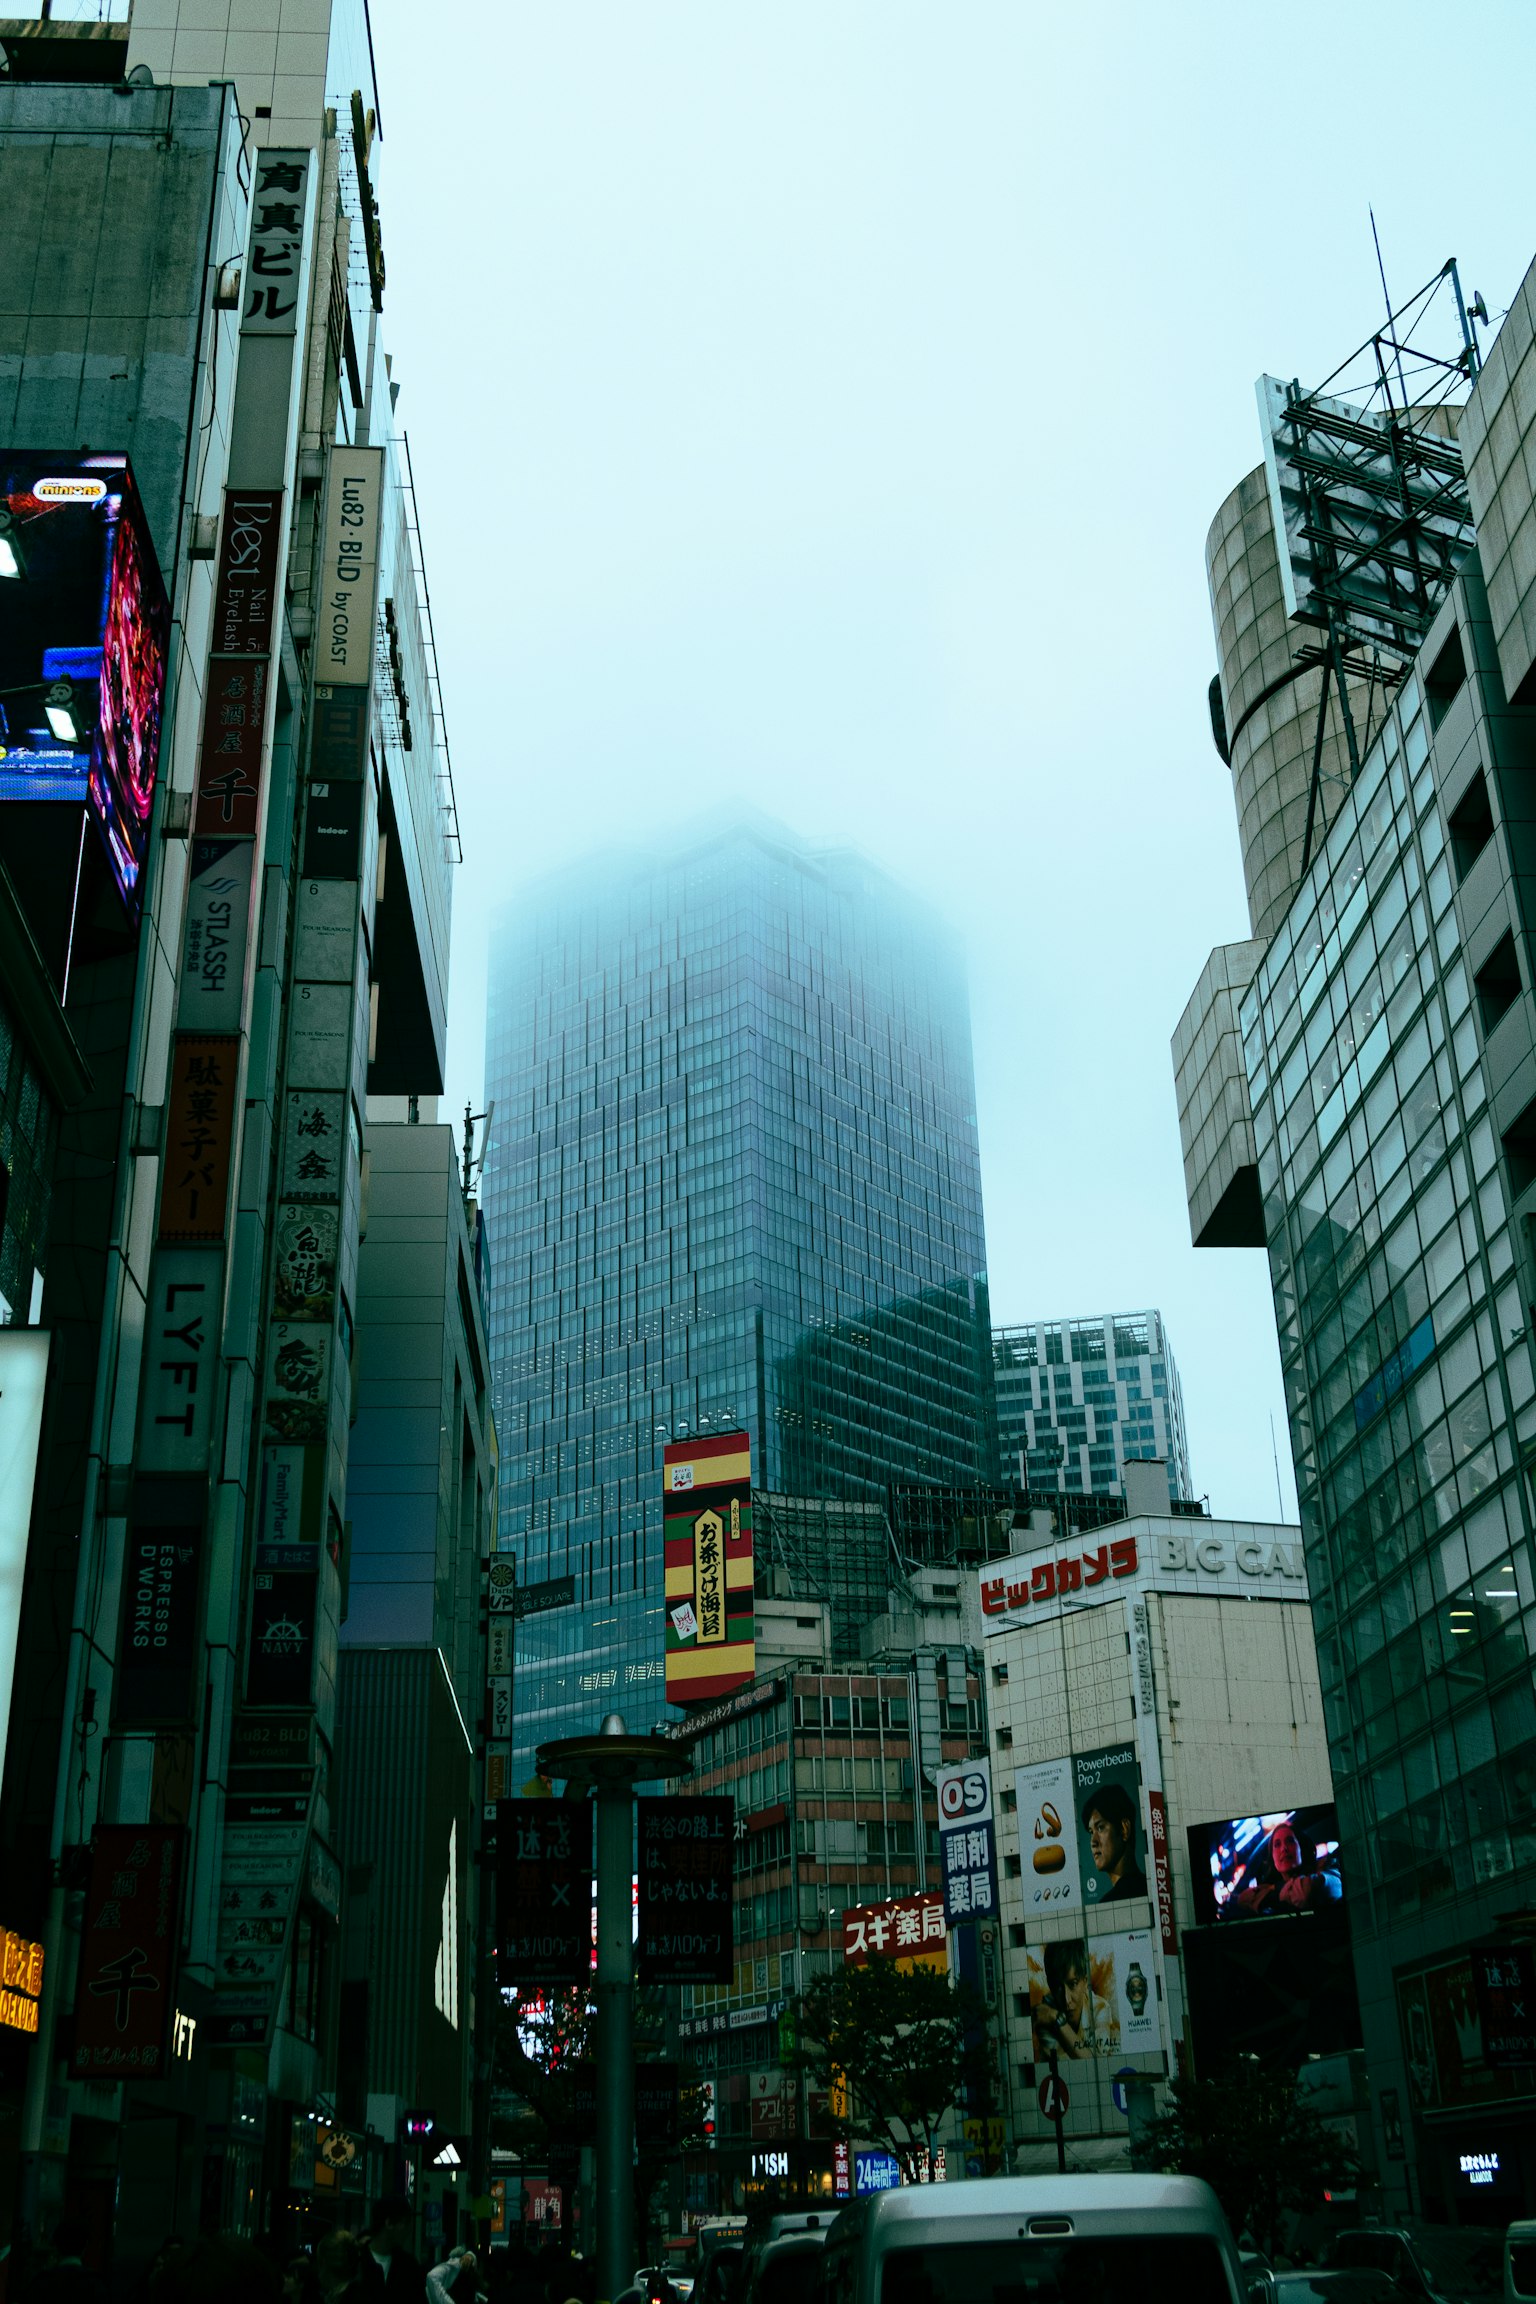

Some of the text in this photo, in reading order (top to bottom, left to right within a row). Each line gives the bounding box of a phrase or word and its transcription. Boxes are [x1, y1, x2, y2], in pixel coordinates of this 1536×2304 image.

[244, 161, 306, 319] 育真ビル
[223, 587, 244, 651] Eyelash
[249, 587, 267, 623] Nail
[320, 688, 328, 698] 8
[200, 675, 257, 823] 居酒屋 千
[316, 784, 325, 795] 7
[200, 847, 219, 859] 3F
[309, 884, 318, 895] 6
[201, 901, 231, 991] STLASSH
[301, 987, 311, 1000] 5
[291, 1094, 300, 1104] 4
[178, 1055, 223, 1220] 駄菓子バー
[287, 1207, 296, 1219] 3
[278, 1325, 288, 1338] 2
[156, 1284, 205, 1436] LYFT
[272, 1464, 291, 1540] FamilyMart
[265, 1550, 312, 1564] 酒 たばこ
[1157, 1536, 1226, 1573] BIC
[257, 1576, 271, 1588] B1
[699, 1522, 721, 1636] お茶づけ海苔
[980, 1537, 1139, 1615] ビックカメラ
[153, 1545, 174, 1647] ESPRESSO
[490, 1595, 513, 1610] UP
[261, 1642, 303, 1653] NAVY
[496, 1689, 509, 1736] スシロー
[1076, 1751, 1133, 1774] Powerbeats
[1077, 1774, 1094, 1787] Pro
[1095, 1771, 1101, 1784] 2
[942, 1775, 985, 1813] OS
[645, 1815, 724, 1839] 渋谷の路上
[1152, 1808, 1166, 1840] 免税
[946, 1827, 989, 1872] 調剤
[647, 1878, 728, 1903] じゃないよ。
[948, 1871, 992, 1915] 薬局
[88, 1839, 160, 2032] 居酒屋 千
[846, 1904, 947, 1955] スギ薬局
[1128, 2018, 1152, 2027] HUAWEI
[637, 2100, 672, 2111] STREET
[638, 2090, 653, 2100] ON
[656, 2090, 673, 2100] THE
[856, 2158, 872, 2190] 24
[873, 2158, 886, 2168] hour
[872, 2168, 889, 2188] 時間
